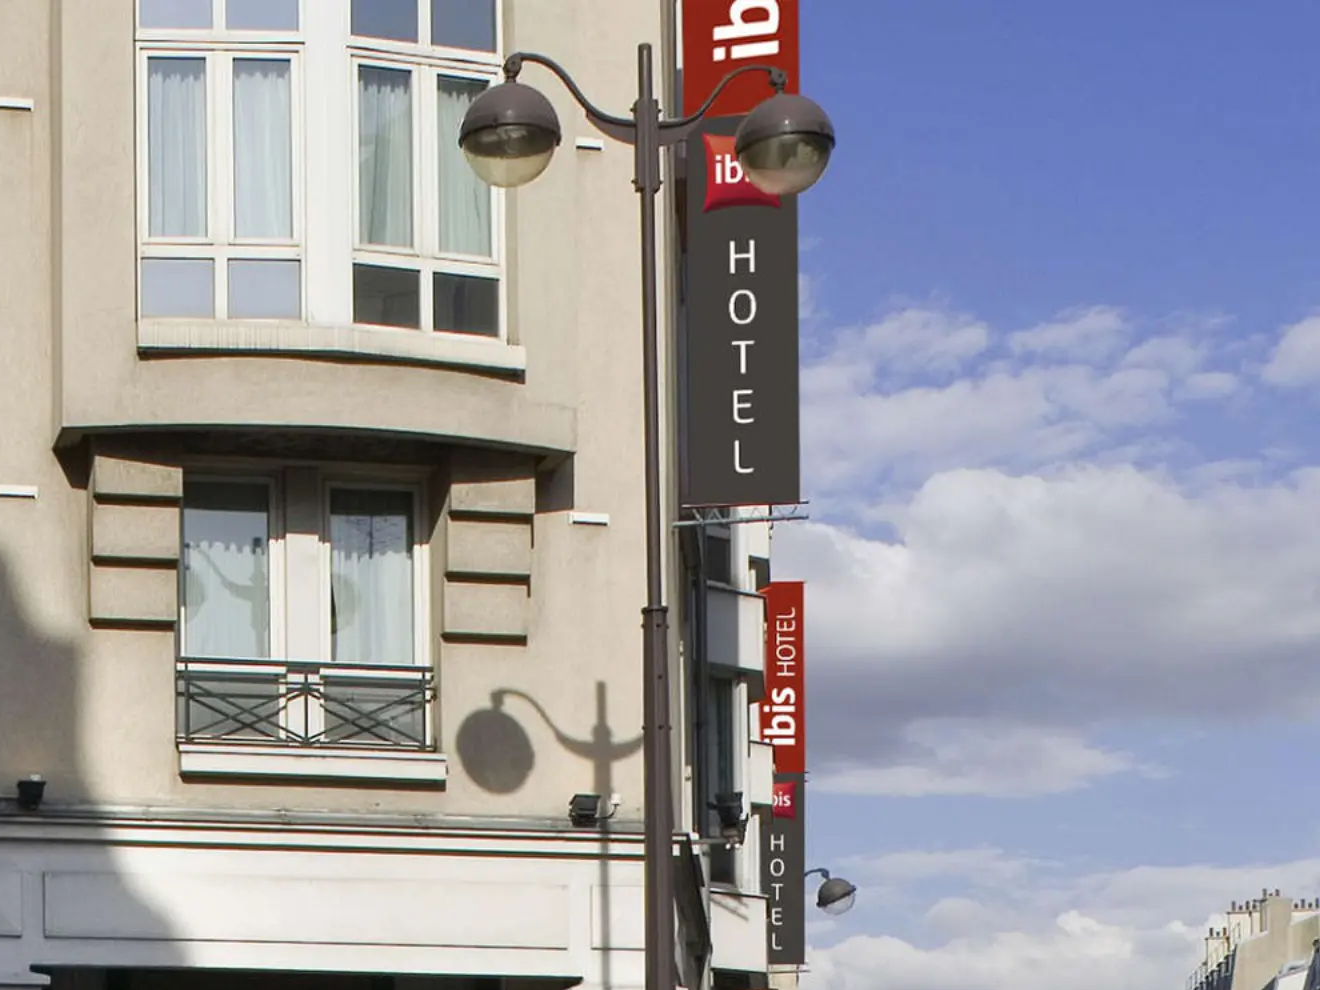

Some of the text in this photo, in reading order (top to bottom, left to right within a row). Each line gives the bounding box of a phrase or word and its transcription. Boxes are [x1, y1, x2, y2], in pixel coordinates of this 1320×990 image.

[715, 154, 750, 184] ib
[729, 239, 758, 474] HOTEL
[763, 607, 796, 745] ibis HOTEL
[770, 834, 785, 950] HOTEL
